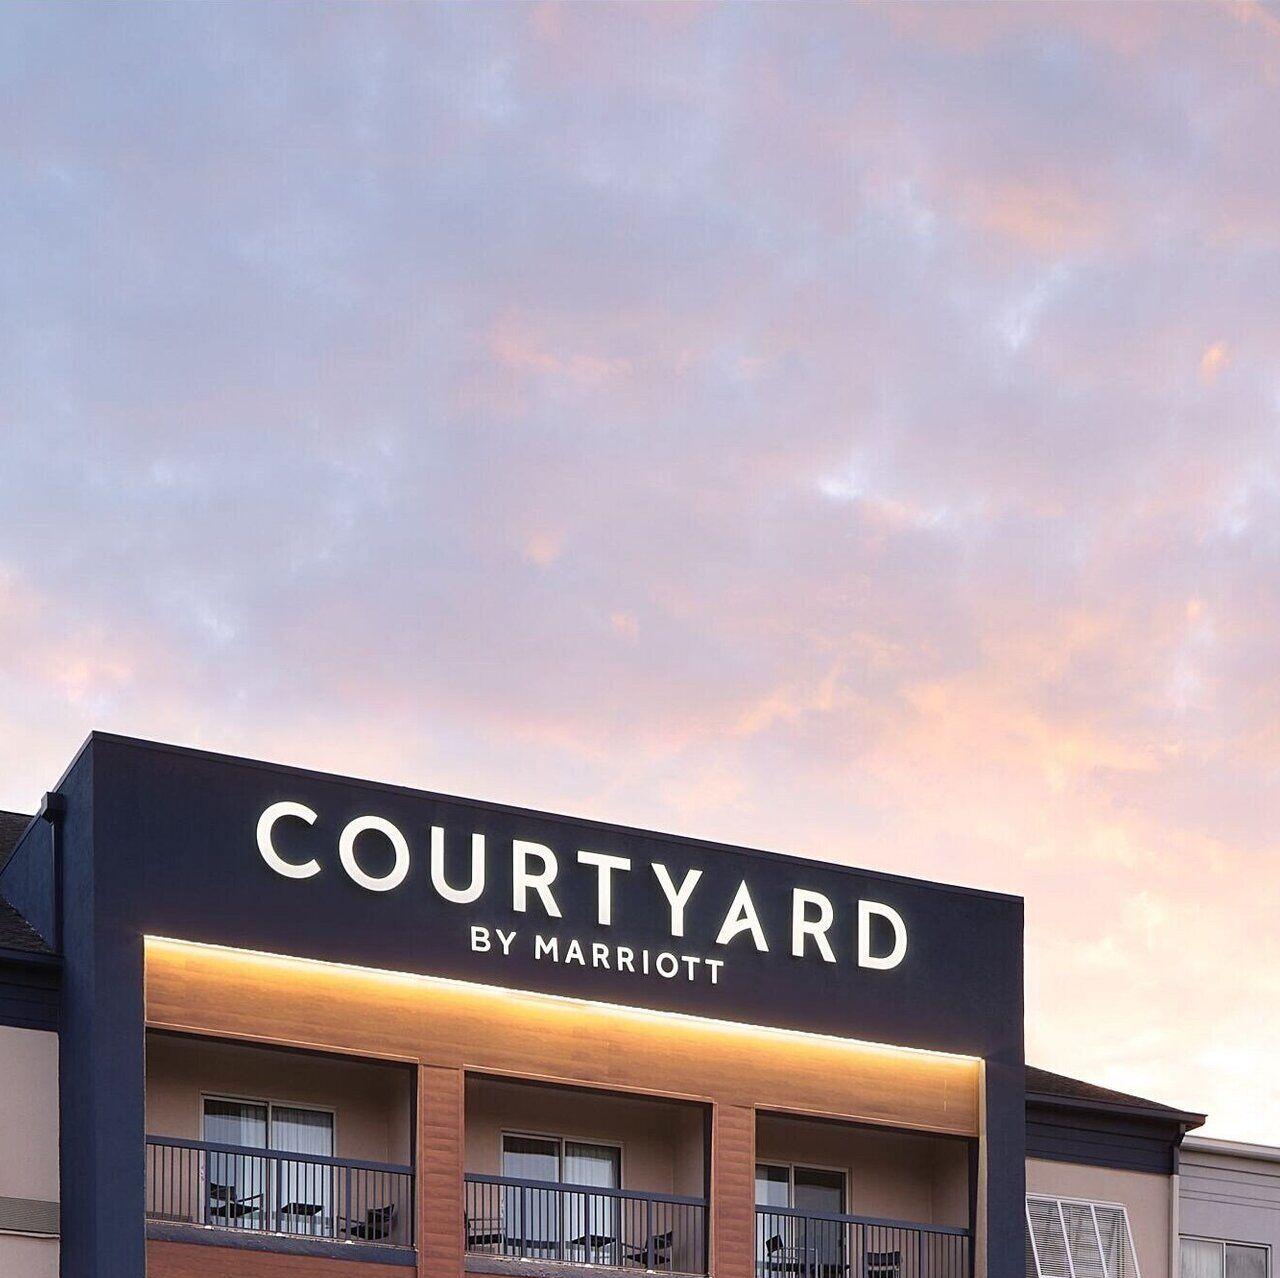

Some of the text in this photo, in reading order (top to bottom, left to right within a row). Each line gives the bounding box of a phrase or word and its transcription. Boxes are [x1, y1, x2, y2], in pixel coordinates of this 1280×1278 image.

[256, 800, 908, 971] COURTYARD
[470, 925, 725, 985] BY MARRIOTT
